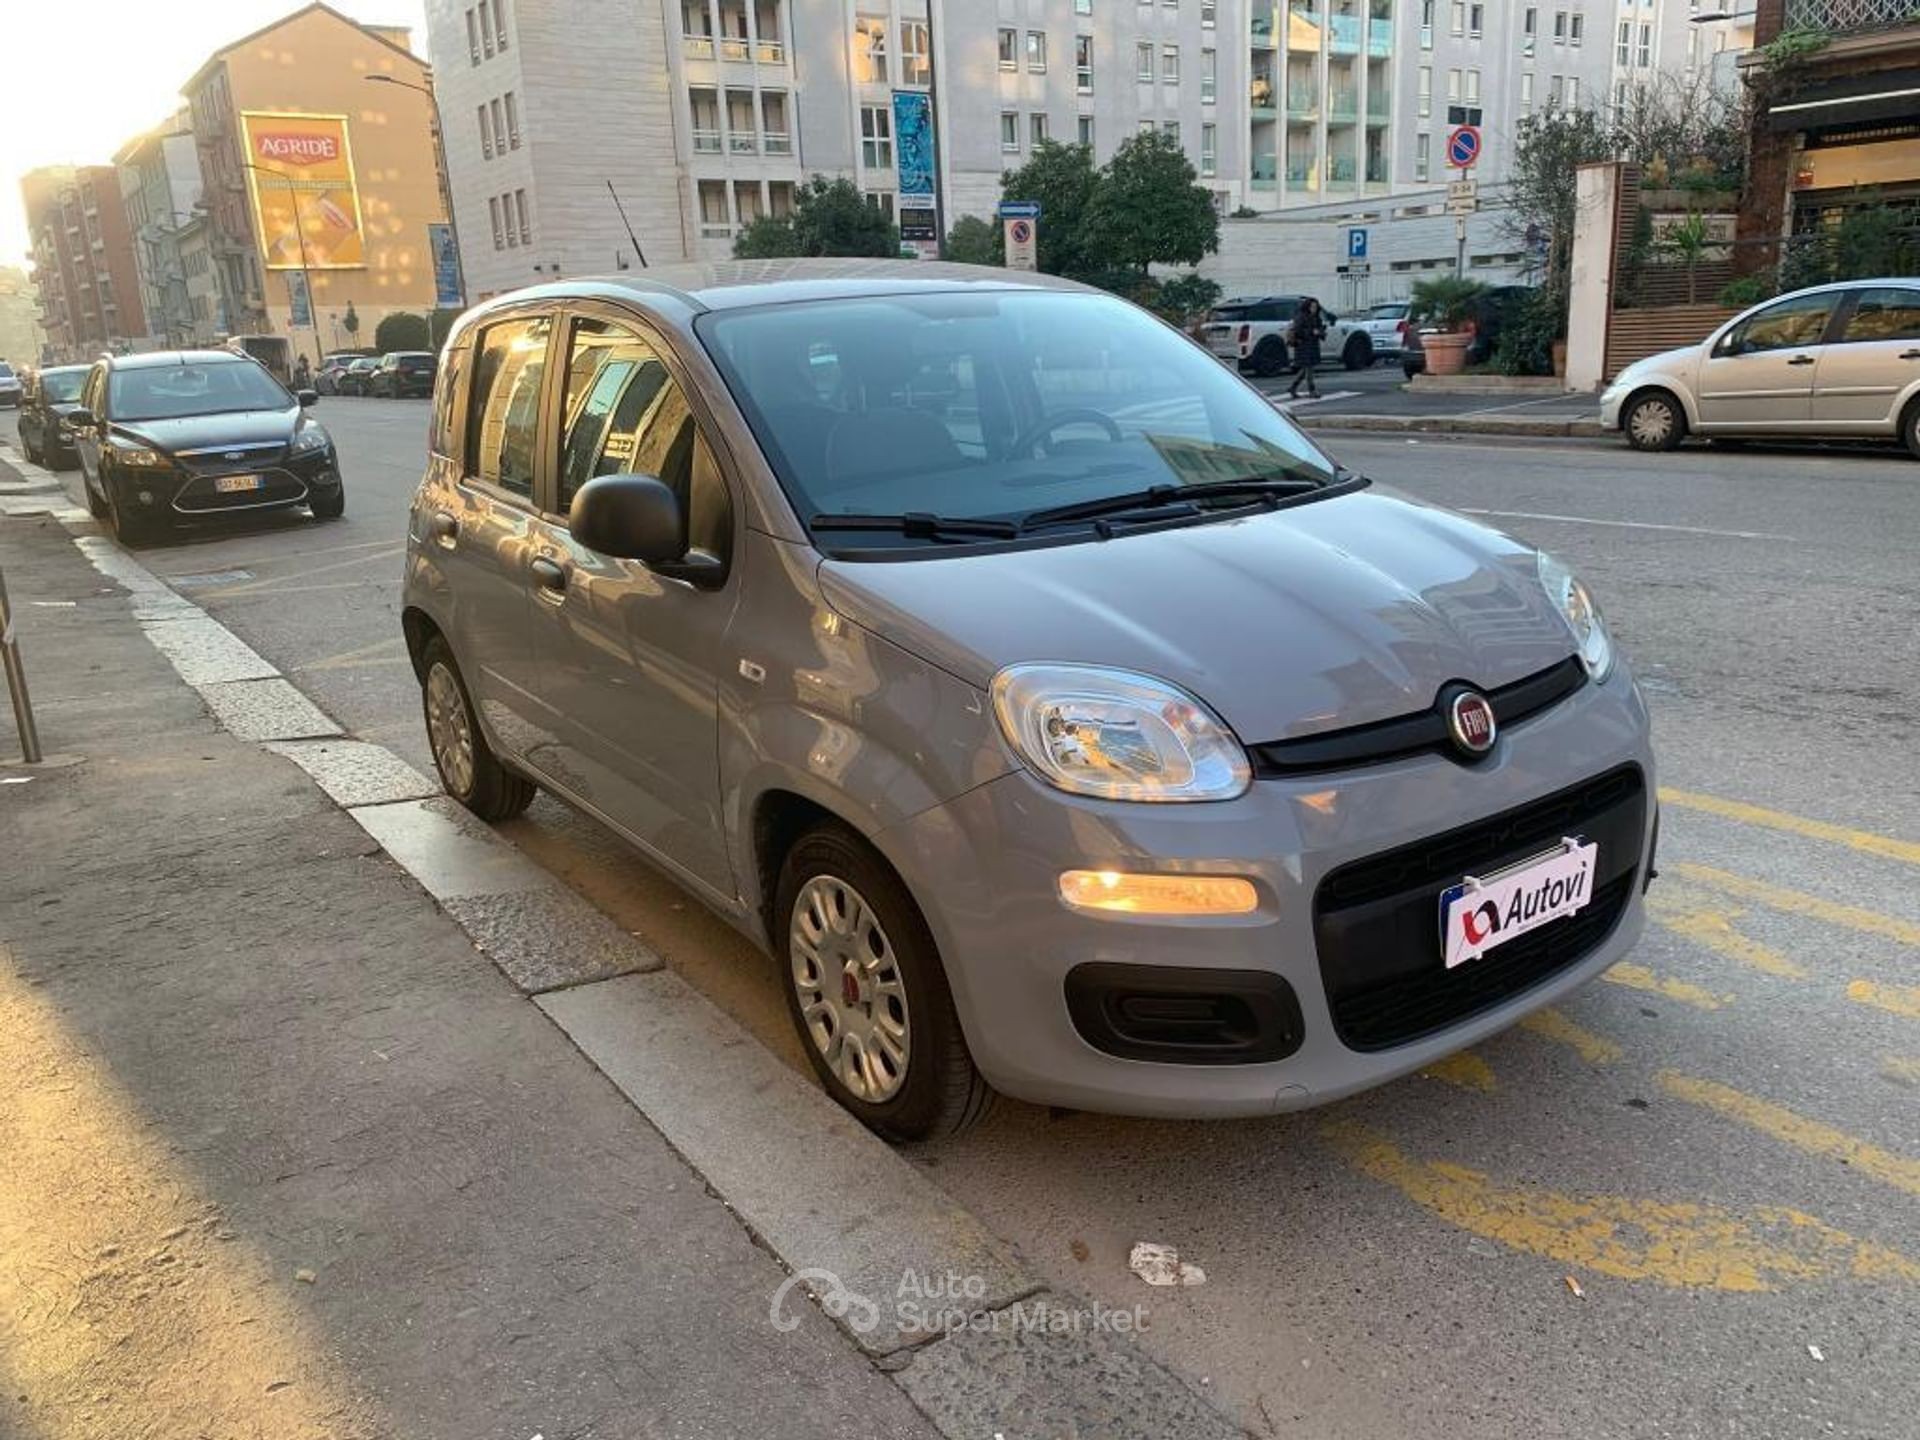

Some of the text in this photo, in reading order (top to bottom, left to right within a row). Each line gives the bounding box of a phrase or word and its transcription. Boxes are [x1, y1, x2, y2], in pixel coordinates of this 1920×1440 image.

[261, 137, 337, 157] AGRIDÈ
[1352, 232, 1365, 255] P
[1462, 709, 1488, 736] FIAT
